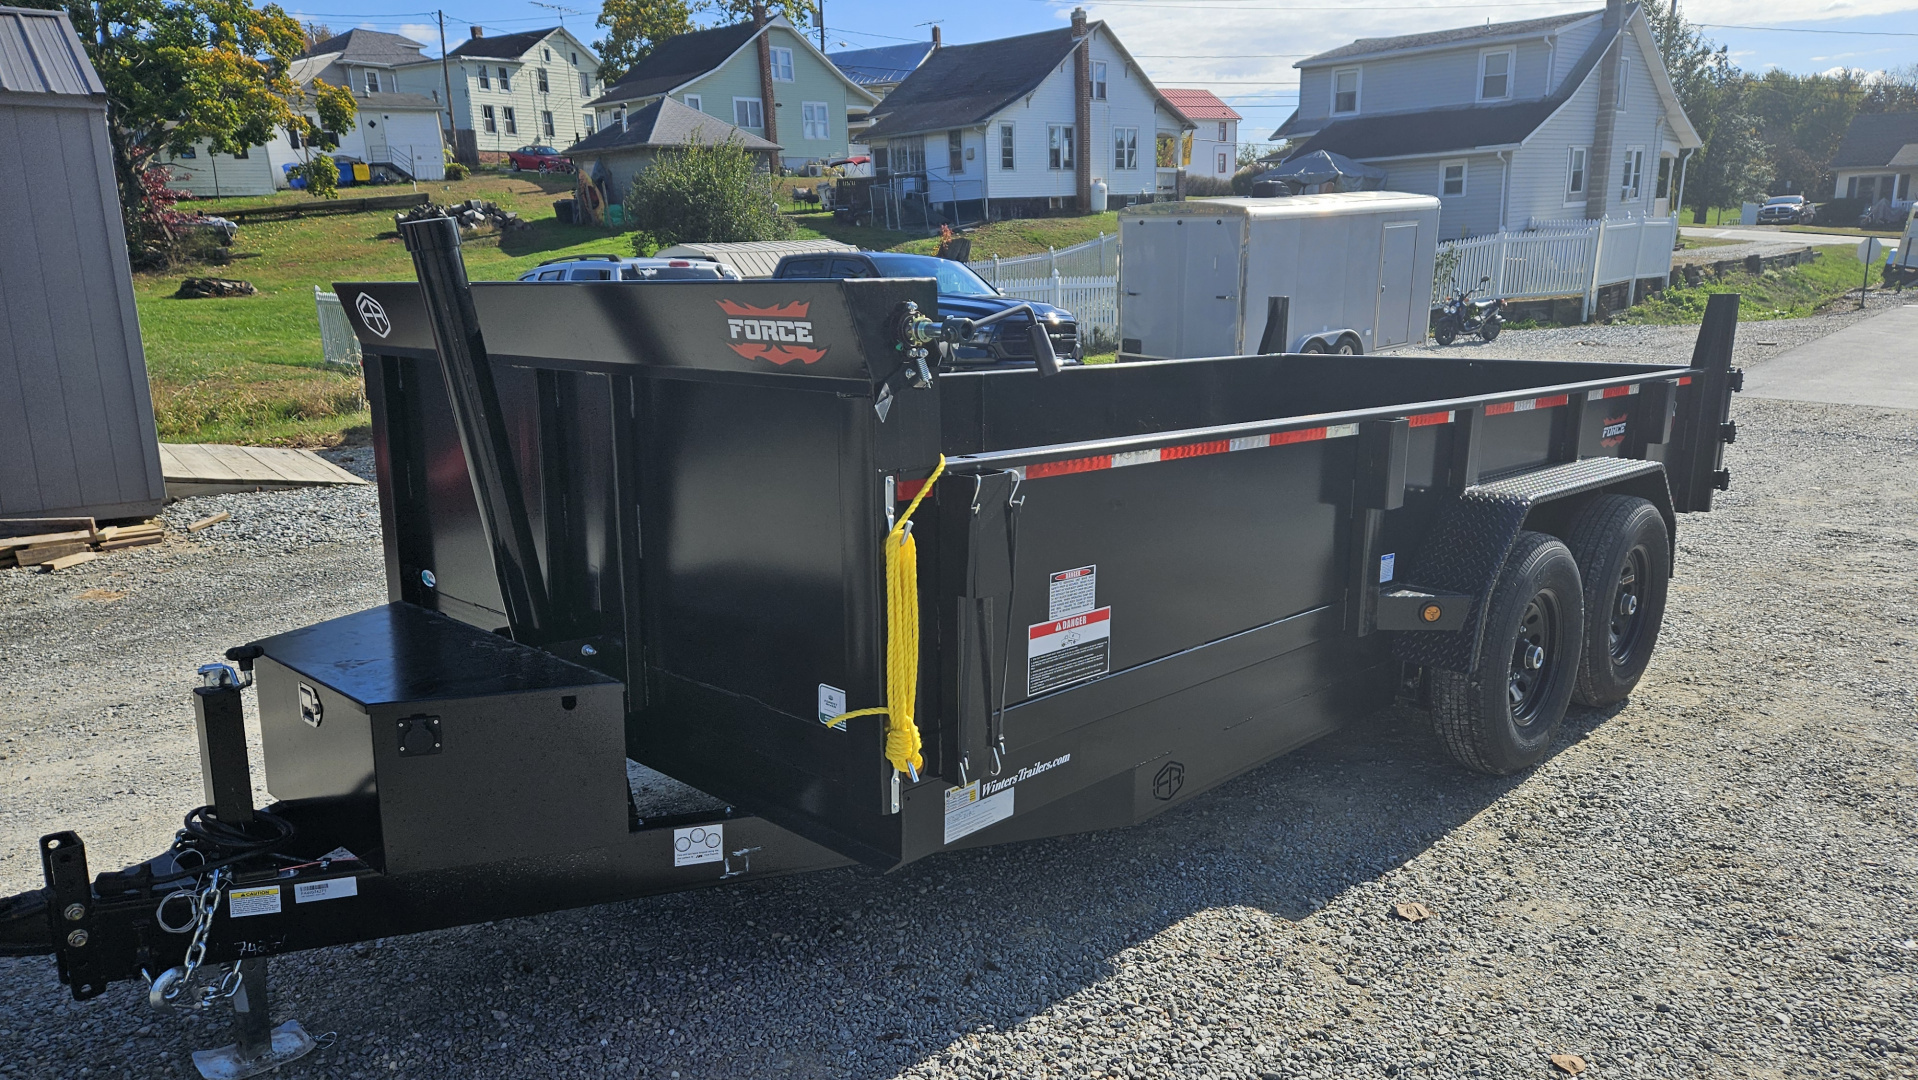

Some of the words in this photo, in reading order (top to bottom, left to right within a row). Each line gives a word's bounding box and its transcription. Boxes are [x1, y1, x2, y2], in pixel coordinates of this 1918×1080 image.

[727, 318, 813, 343] FORCE
[1602, 422, 1627, 438] FORCE
[1062, 615, 1087, 630] DANGER
